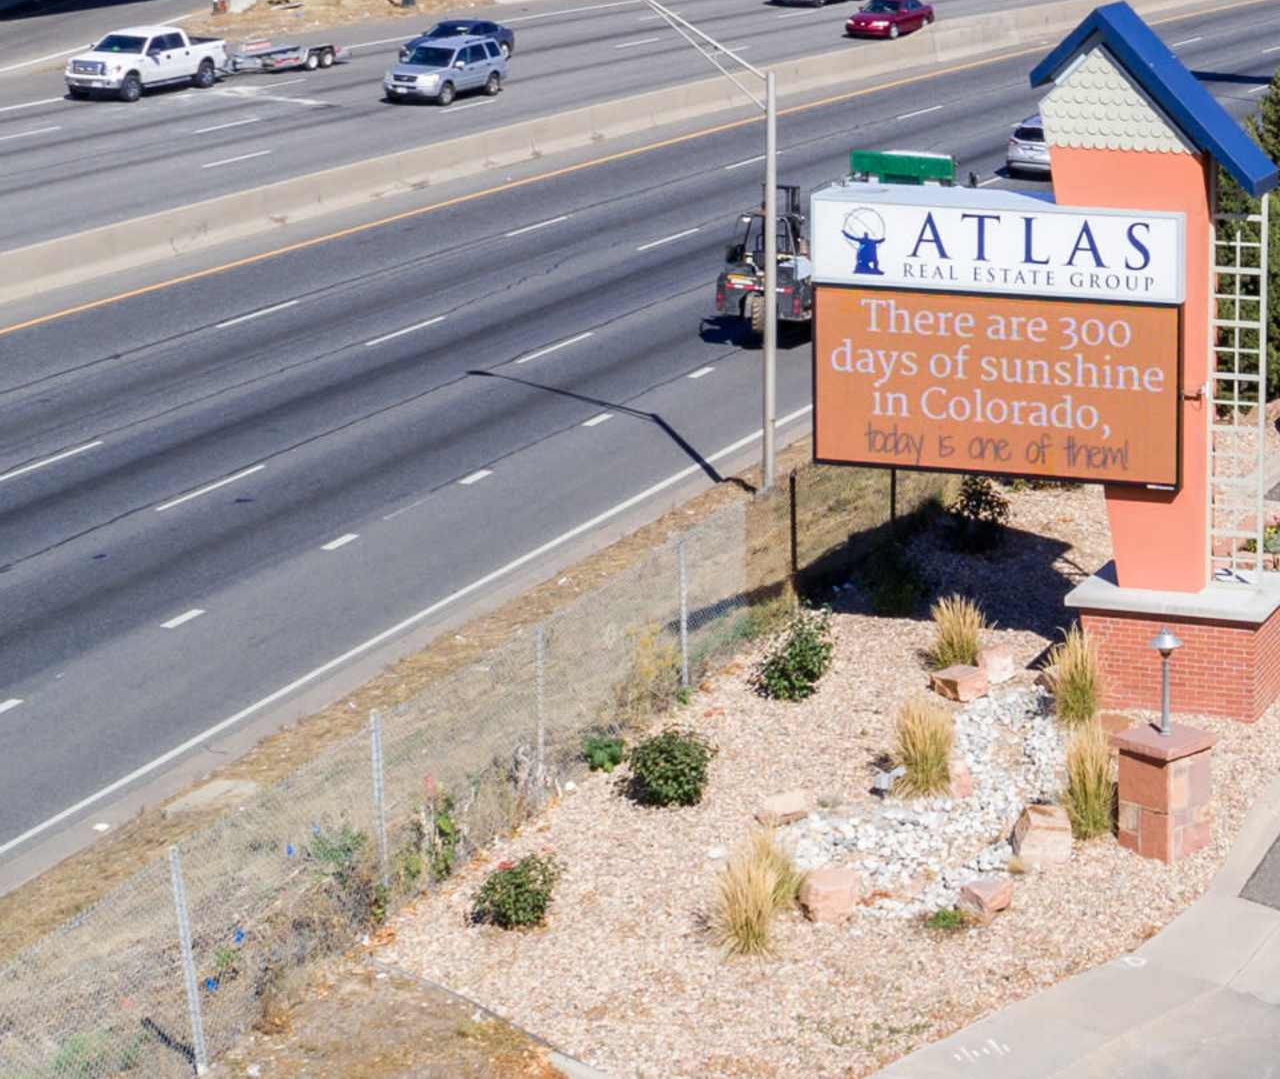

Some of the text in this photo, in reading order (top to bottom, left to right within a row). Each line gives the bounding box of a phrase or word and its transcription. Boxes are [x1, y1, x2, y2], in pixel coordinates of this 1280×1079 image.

[906, 211, 1152, 271] ATLAS
[903, 262, 1155, 292] REAL ESTATE GROUP
[860, 298, 1133, 351] There are 300
[830, 338, 1165, 392] days of sunshine
[872, 383, 1112, 438] in Colorado,
[864, 422, 1129, 471] today is one of them!
